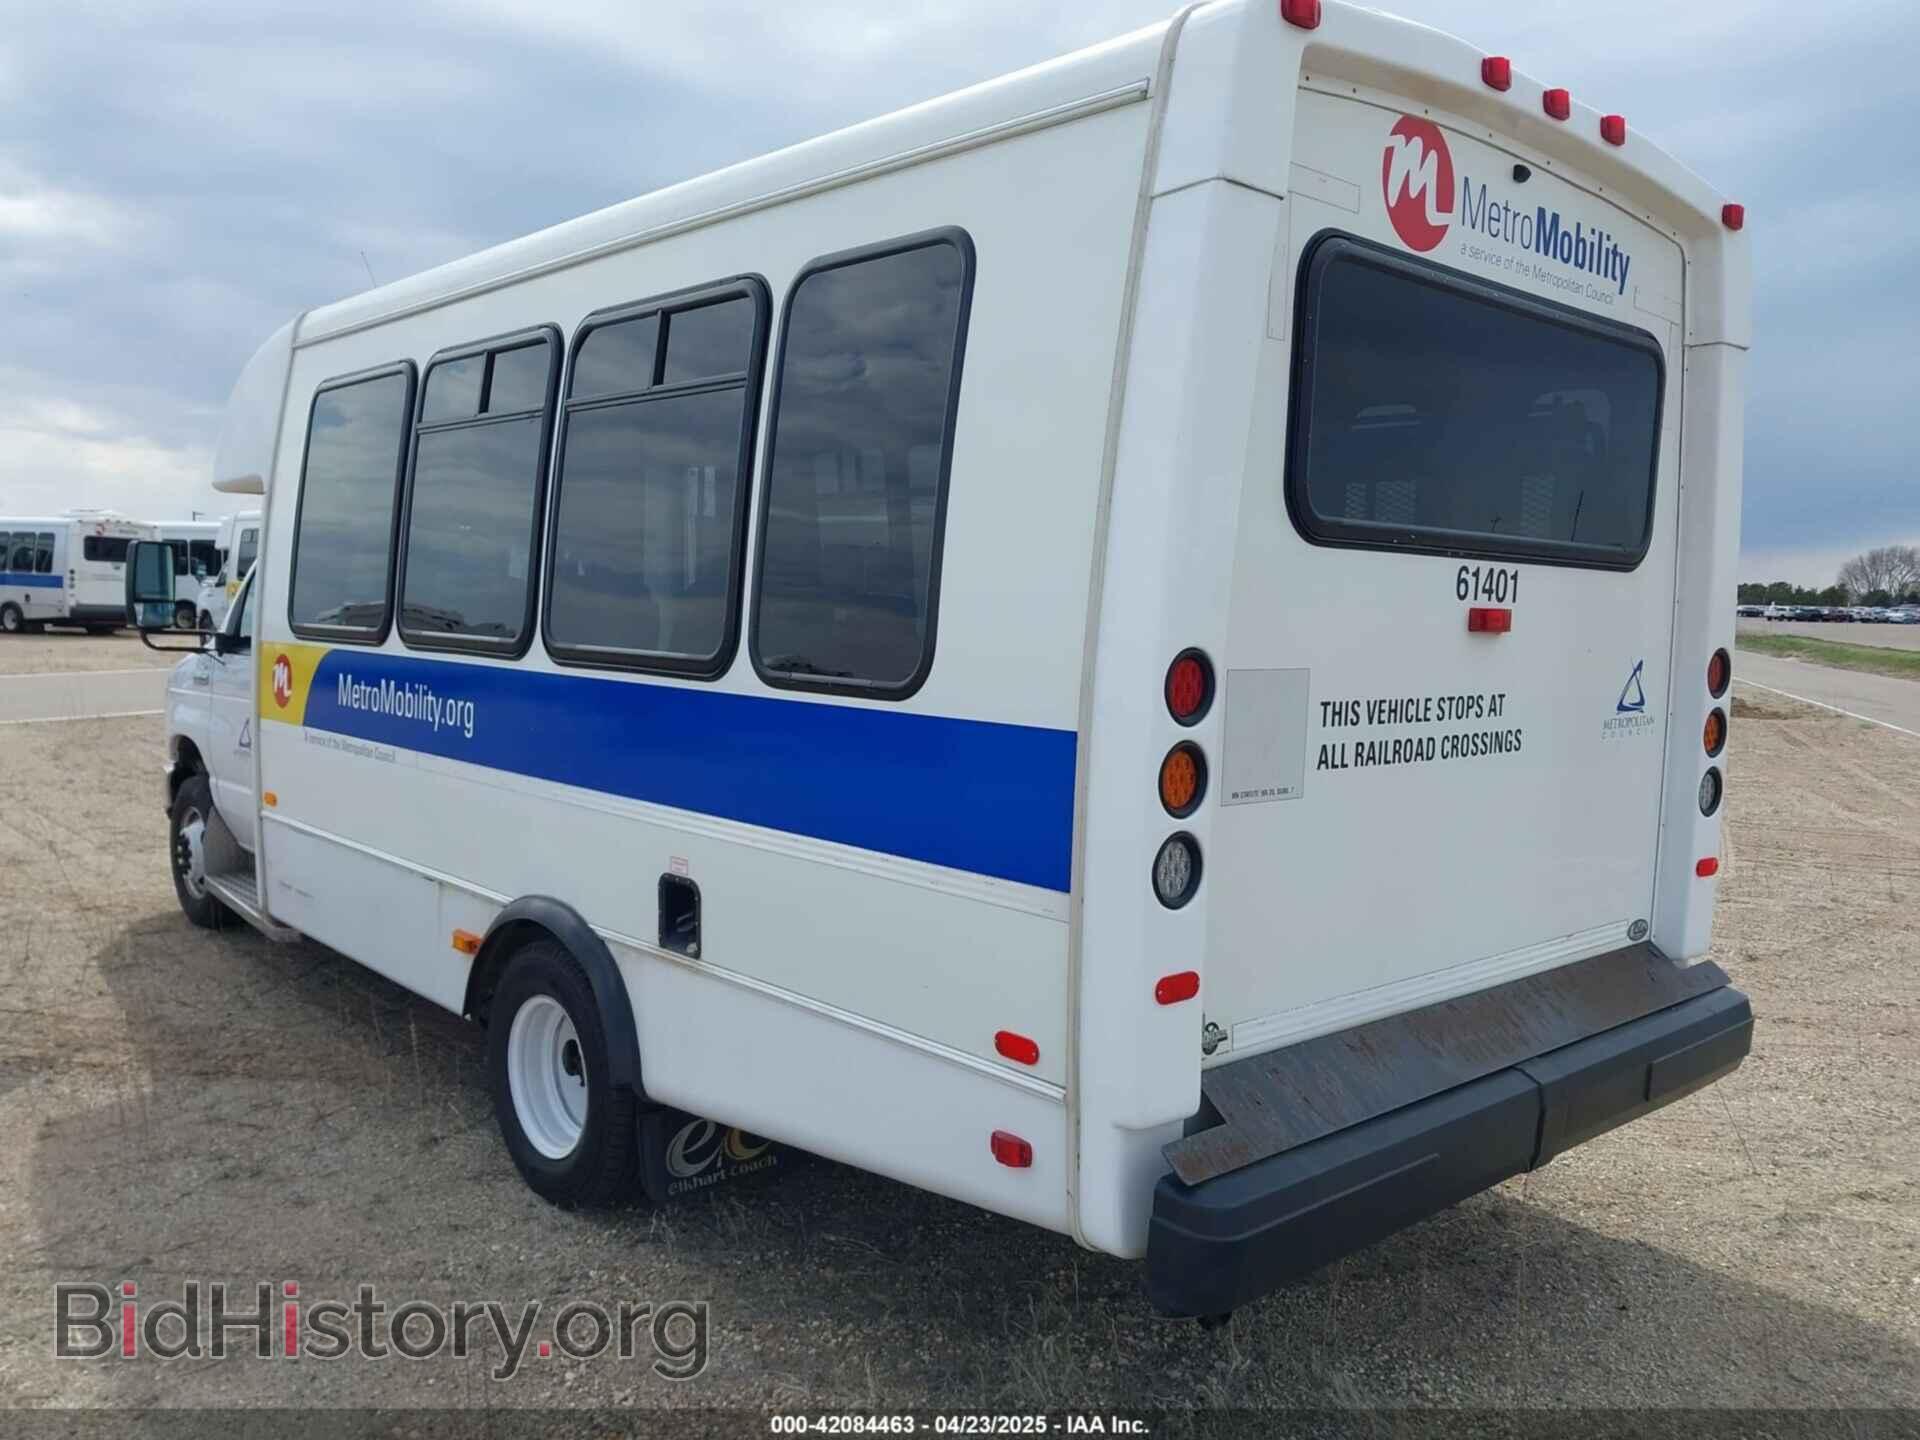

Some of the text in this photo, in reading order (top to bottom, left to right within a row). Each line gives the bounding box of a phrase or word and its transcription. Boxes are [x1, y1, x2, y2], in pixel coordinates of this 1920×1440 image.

[1461, 176, 1631, 295] MetroMobility
[1460, 243, 1467, 255] a
[1468, 245, 1501, 267] service
[1503, 256, 1514, 270] of
[1515, 260, 1531, 277] the
[1532, 264, 1584, 297] Metropolitan
[1456, 565, 1519, 604] 61401
[337, 673, 475, 738] MetroMobility.org
[1320, 693, 1506, 728] THIS VEHICLE STOPS AT
[1316, 728, 1522, 771] ALL RAILROAD CROSSINGS
